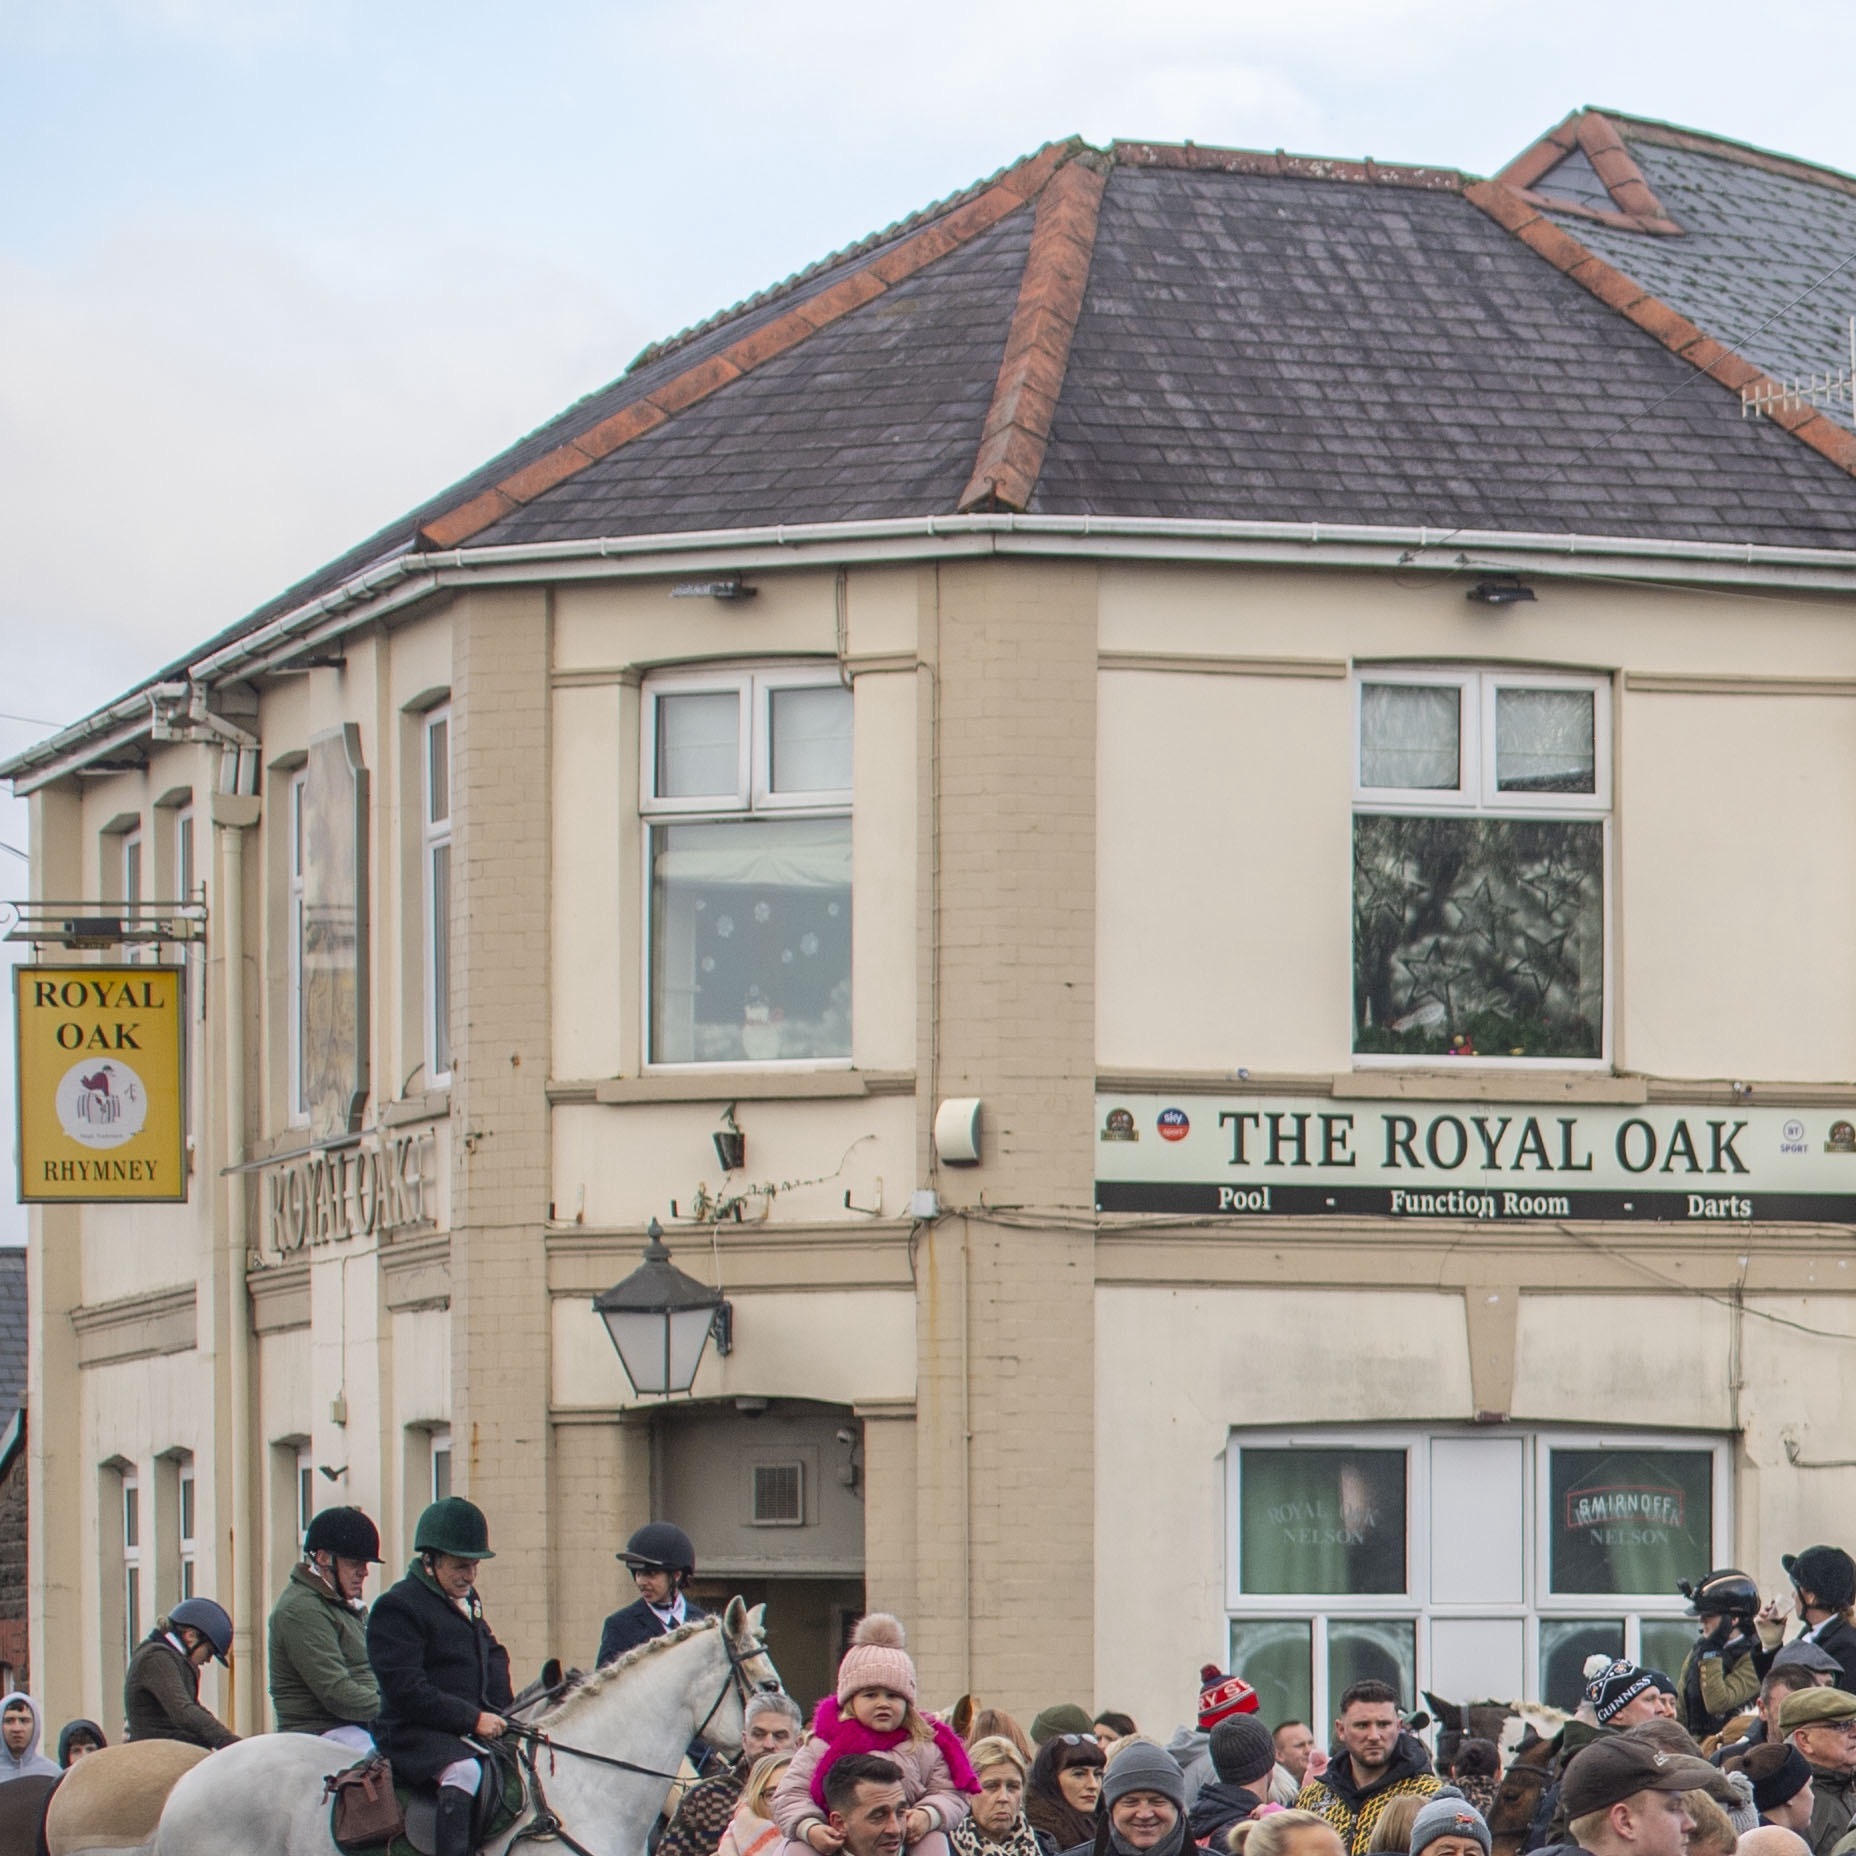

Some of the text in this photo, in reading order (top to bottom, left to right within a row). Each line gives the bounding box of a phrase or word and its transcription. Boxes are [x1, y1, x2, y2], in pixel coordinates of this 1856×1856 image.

[33, 981, 165, 1008] ROYAL
[55, 1022, 142, 1050] OAK
[1218, 1111, 1750, 1173] THE ROYAL OAK
[43, 1160, 158, 1182] RHYMNEY
[1218, 1186, 1271, 1211] Pool
[1390, 1189, 1496, 1217] Function
[1503, 1191, 1569, 1216] Room
[1687, 1194, 1752, 1217] Darts
[1579, 1493, 1672, 1516] SMIRNOFF
[1283, 1528, 1364, 1544] NELSON
[1590, 1529, 1668, 1545] NELSON
[1598, 1675, 1652, 1721] GUINNESS
